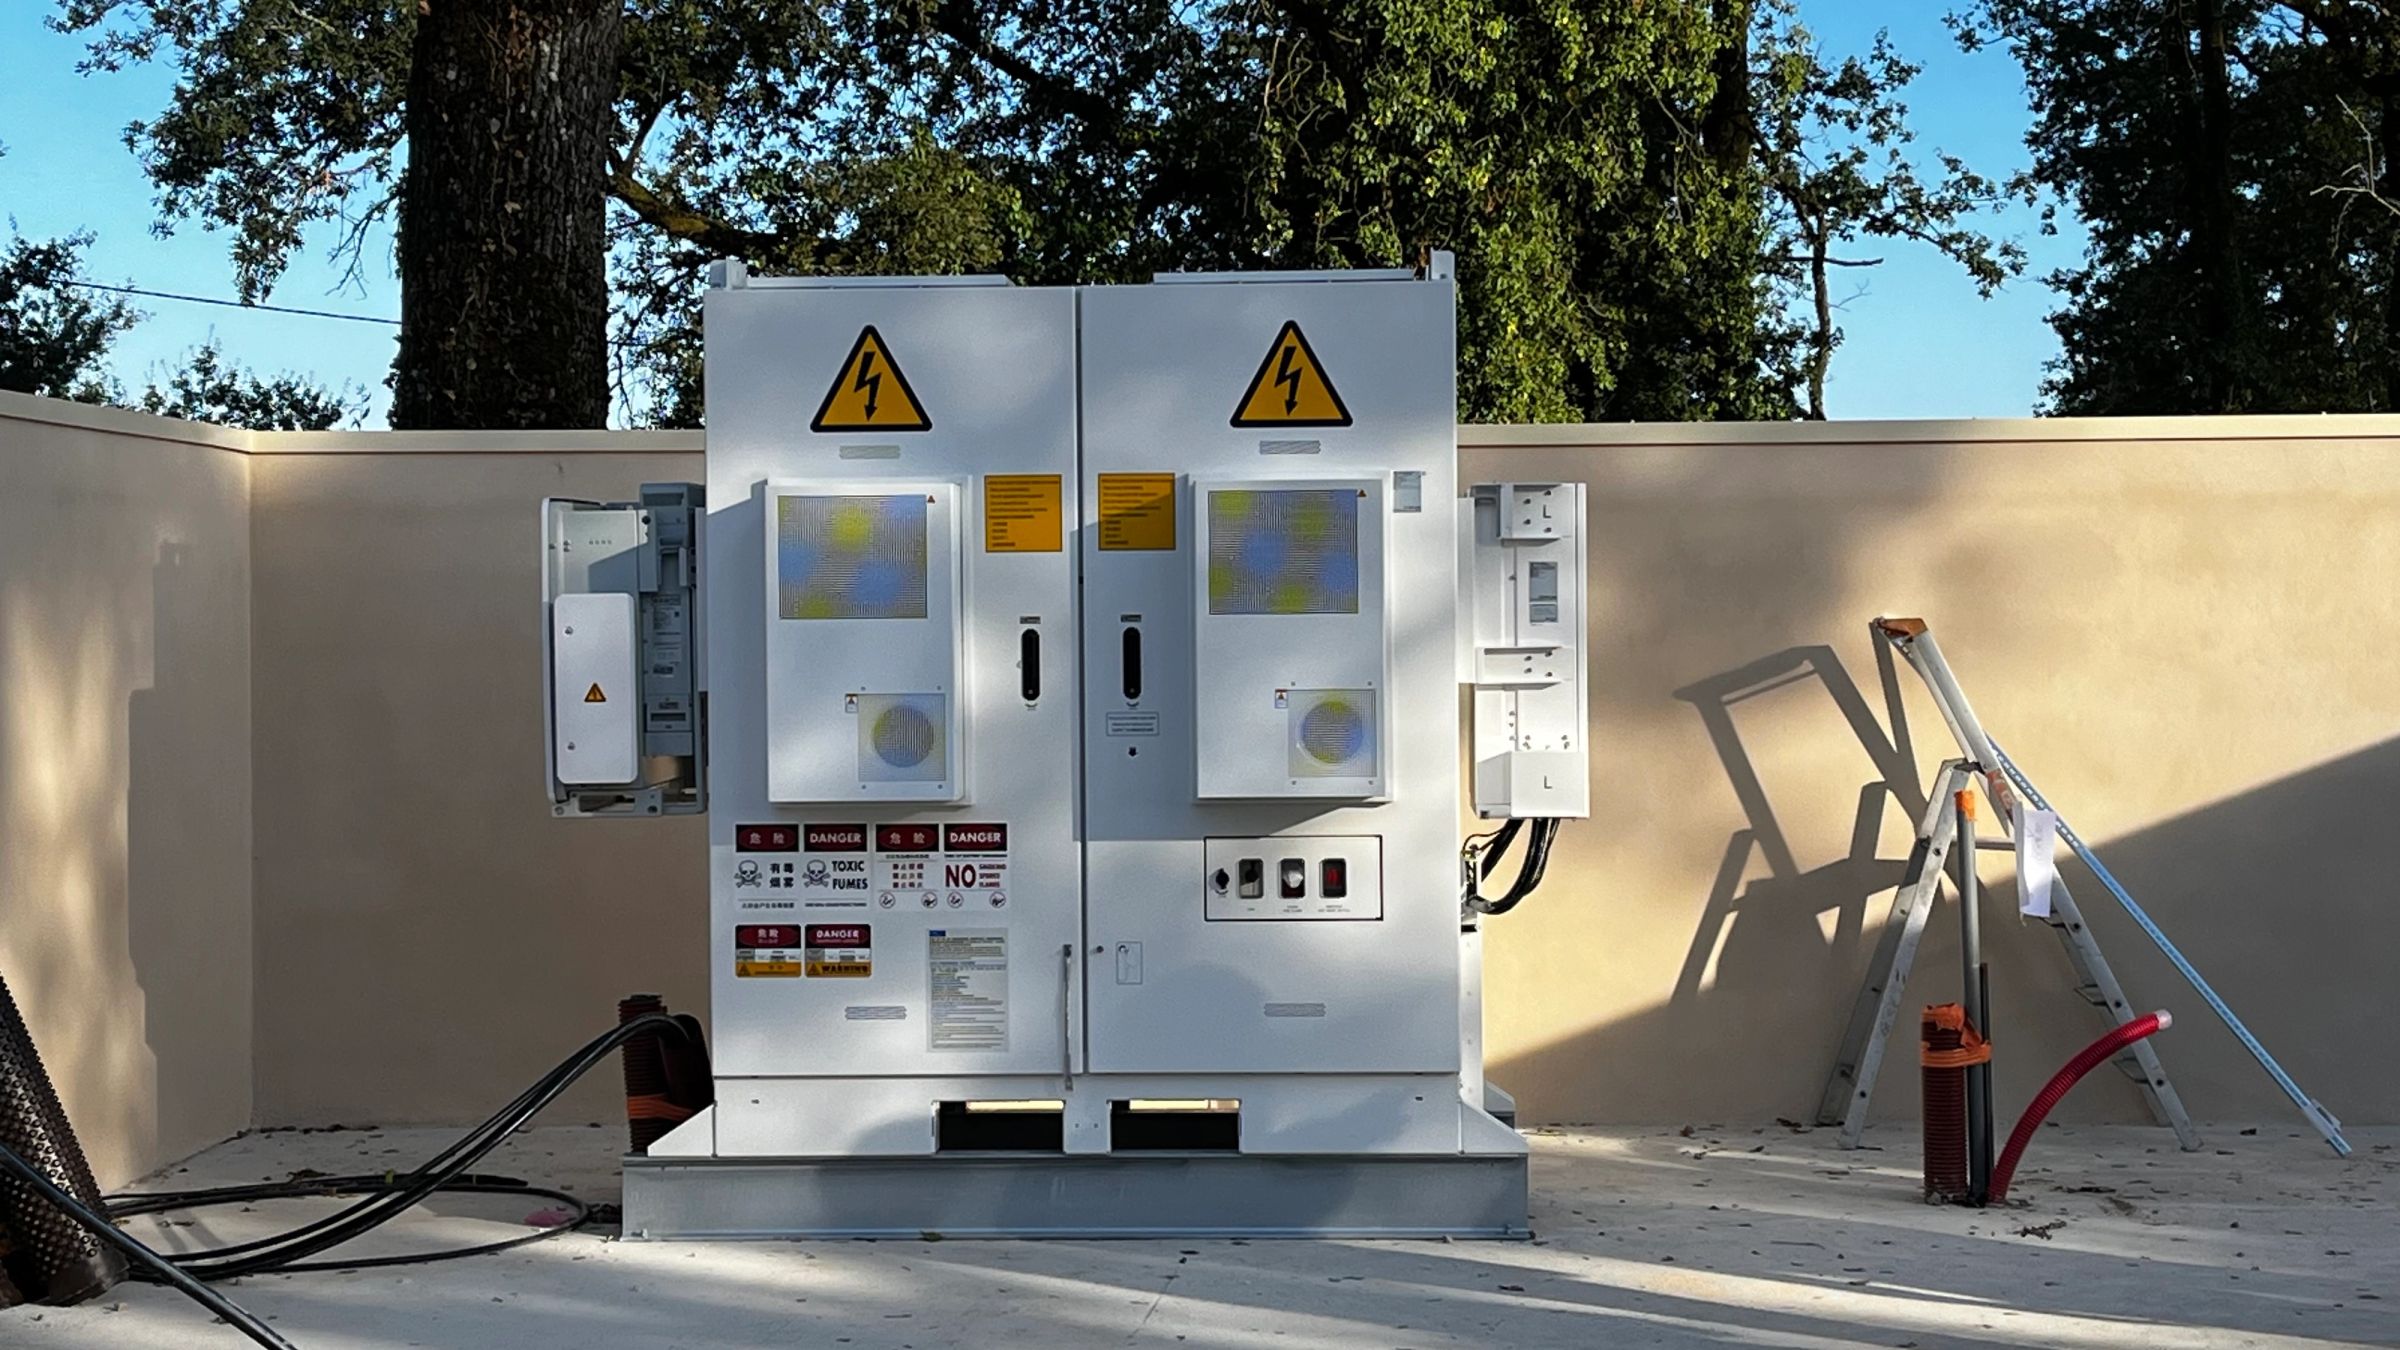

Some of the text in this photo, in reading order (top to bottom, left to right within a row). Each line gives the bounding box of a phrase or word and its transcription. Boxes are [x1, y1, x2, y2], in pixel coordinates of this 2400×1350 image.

[1542, 505, 1552, 519] L
[1544, 776, 1552, 789] L
[750, 833, 785, 845] 危险
[810, 833, 861, 843] DANGER
[950, 833, 1001, 843] DANGER
[832, 861, 864, 872] TOXIC
[945, 864, 976, 888] NO
[833, 878, 868, 889] FUMES
[817, 930, 859, 938] DANGER
